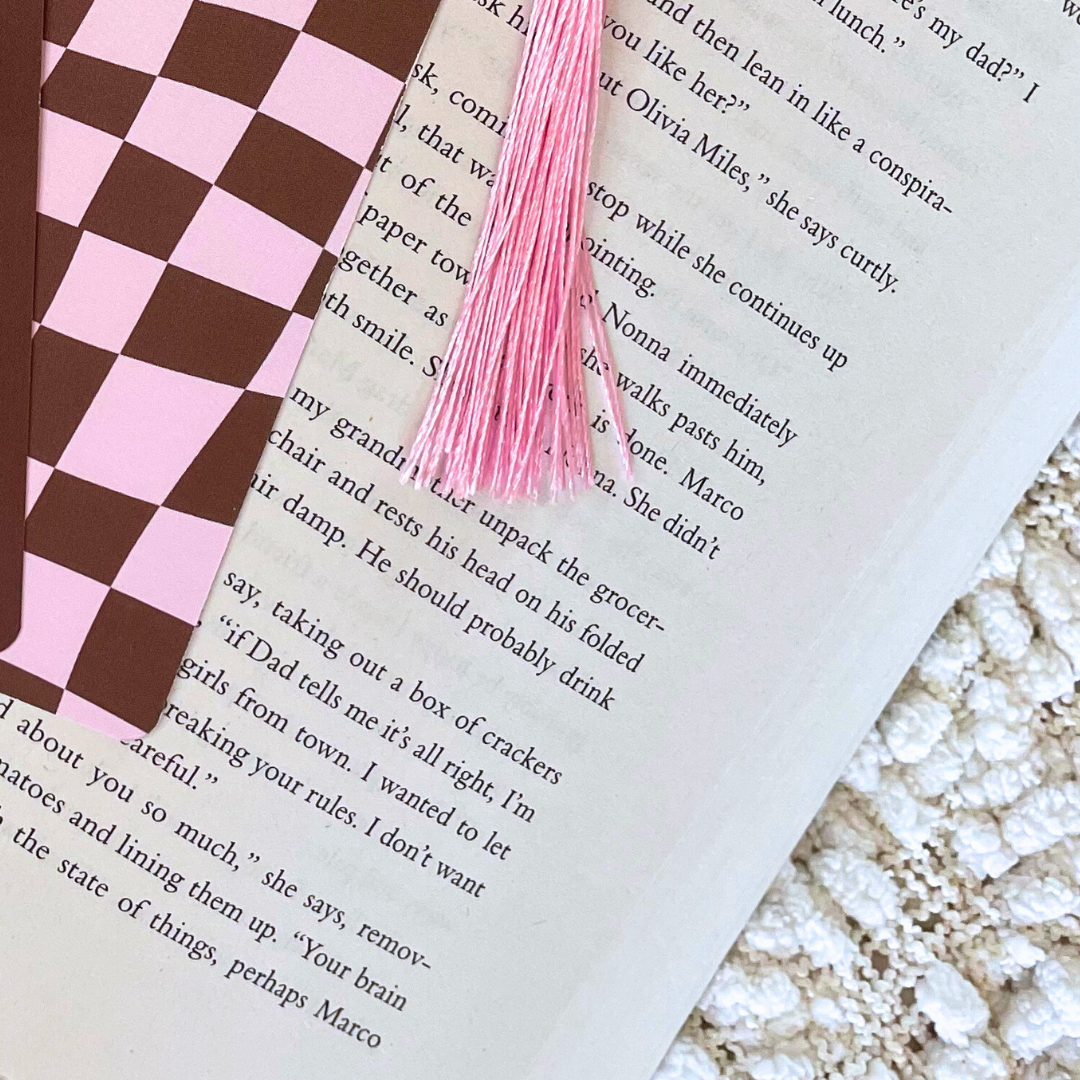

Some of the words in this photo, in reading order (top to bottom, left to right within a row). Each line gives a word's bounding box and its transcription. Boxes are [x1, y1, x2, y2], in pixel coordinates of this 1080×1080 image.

[926, 15, 964, 50] my
[964, 40, 1026, 83] dad?”
[1021, 80, 1041, 104] I
[585, 180, 630, 223] stop
[634, 212, 691, 260] while
[690, 252, 727, 285] she
[727, 280, 821, 350] continues
[821, 343, 849, 373] up
[625, 87, 691, 146] Olivia
[690, 132, 771, 194] Miles,”
[764, 188, 800, 221] she
[798, 214, 840, 250] says
[839, 244, 900, 294] curtly.
[599, 300, 672, 363] Nonna
[676, 352, 799, 449] immediately
[222, 571, 263, 609] say,
[270, 599, 346, 661] taking
[348, 651, 388, 682] out
[389, 676, 404, 693] a
[407, 679, 452, 720] box
[453, 714, 488, 736] of
[480, 730, 563, 786] crackers
[281, 492, 347, 549] damp.
[354, 536, 392, 574] He
[393, 566, 471, 620] should
[461, 613, 557, 677] probably
[558, 665, 616, 712] drink
[11, 826, 51, 861] the
[55, 858, 110, 898] state
[116, 896, 152, 920] of
[148, 911, 217, 967] things,
[222, 958, 309, 1009] perhaps
[312, 998, 382, 1049] Marco
[67, 810, 118, 846] and
[113, 832, 186, 894] lining
[187, 879, 244, 924] them
[247, 915, 277, 944] up.
[292, 930, 353, 980] “Your
[352, 965, 408, 1012] brain
